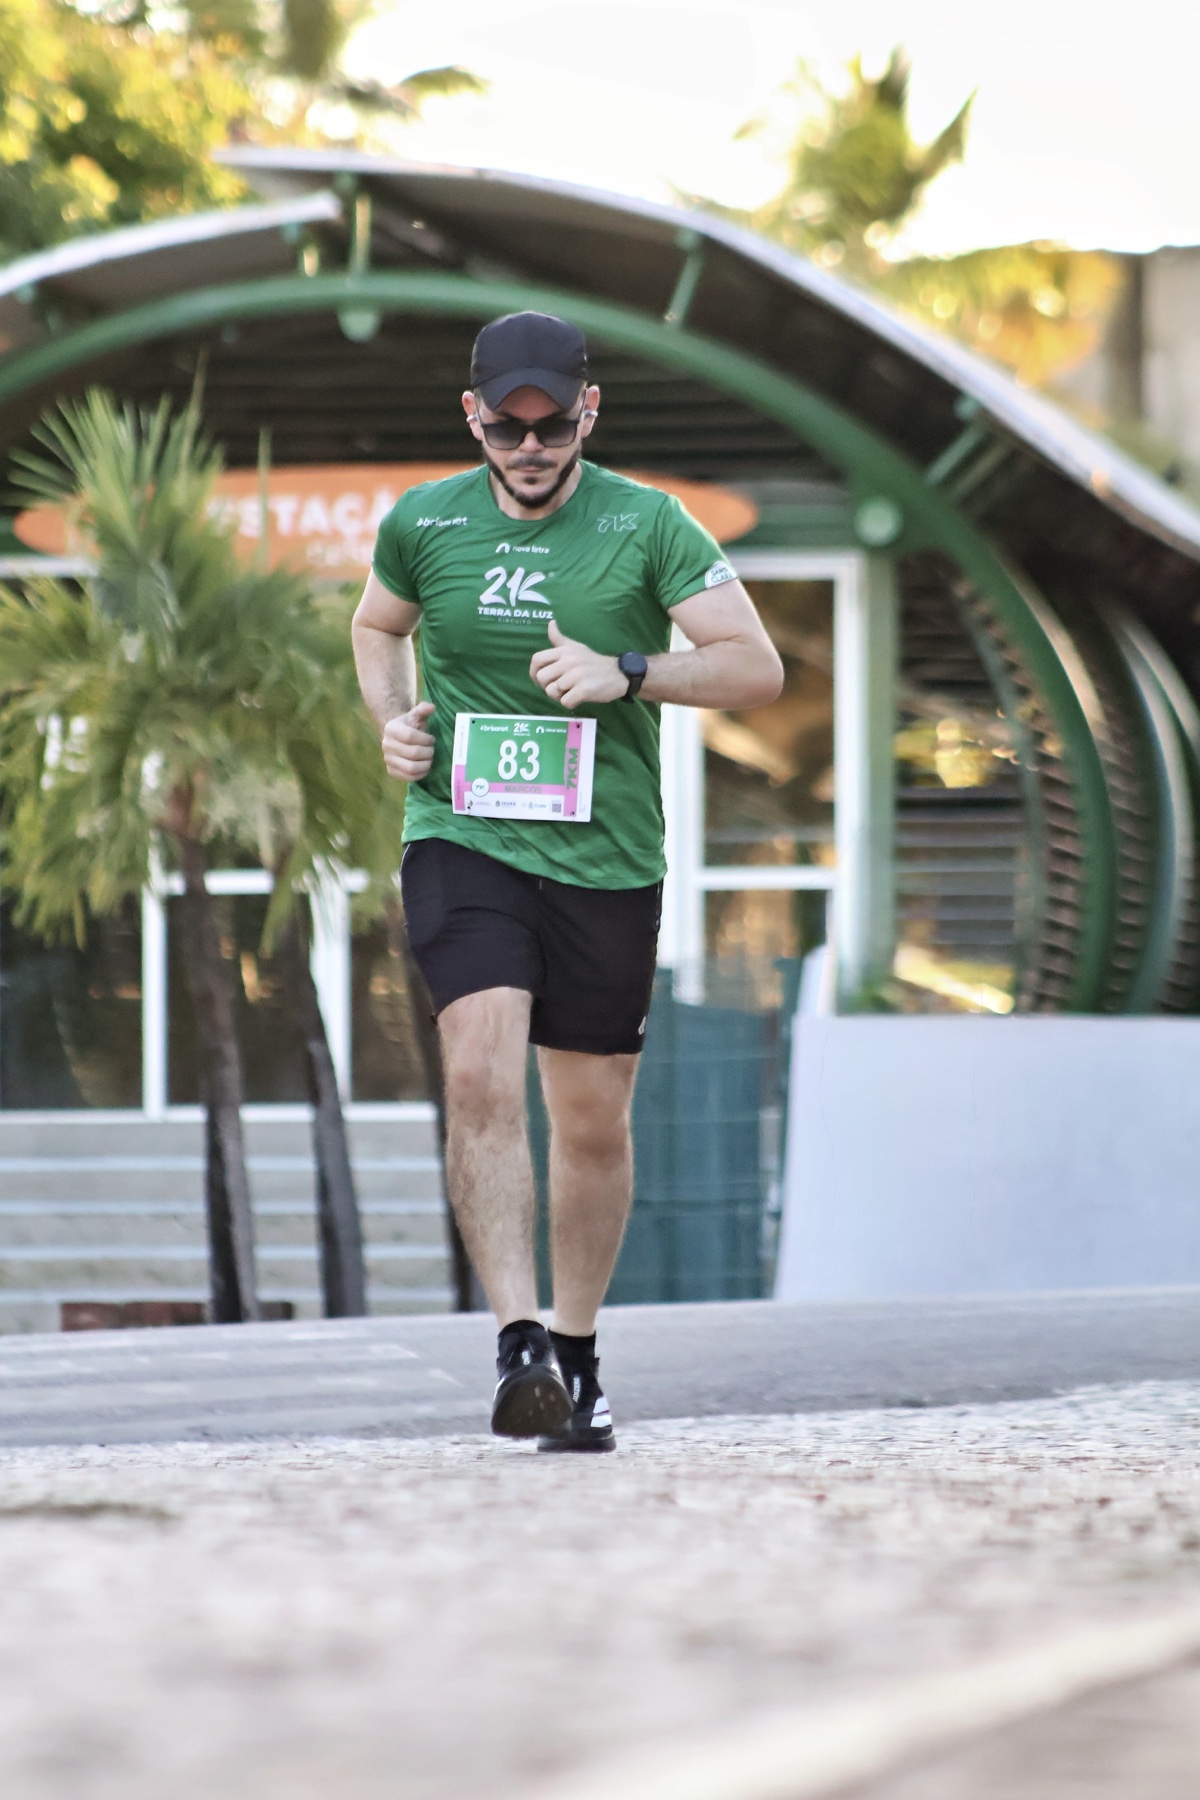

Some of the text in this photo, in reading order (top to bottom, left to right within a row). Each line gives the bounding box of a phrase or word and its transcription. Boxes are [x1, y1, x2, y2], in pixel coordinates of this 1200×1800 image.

[512, 545, 550, 554] nova letra
[477, 606, 554, 619] TERRA DA LUZ
[498, 740, 540, 781] 83
[566, 748, 579, 791] 7KM
